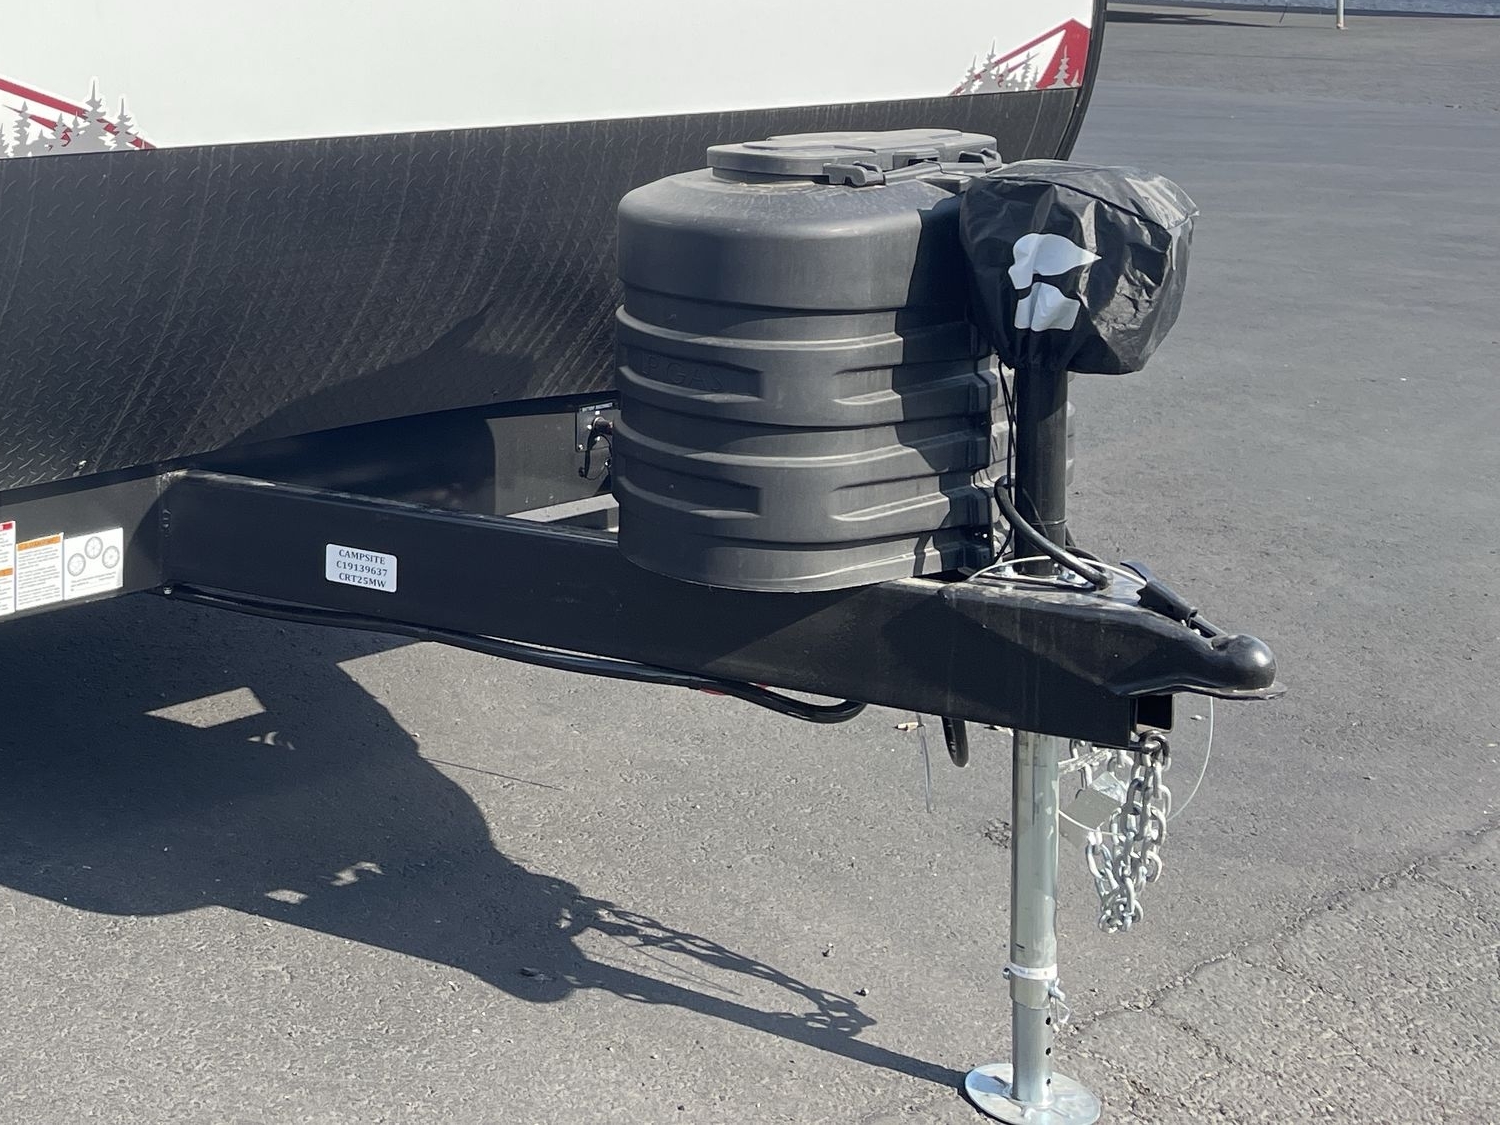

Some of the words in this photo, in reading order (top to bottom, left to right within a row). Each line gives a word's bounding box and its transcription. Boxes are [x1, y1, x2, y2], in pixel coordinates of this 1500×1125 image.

[339, 548, 386, 565] CAMPSITE
[336, 560, 388, 577] C19139637
[338, 572, 387, 588] CRT25MW
